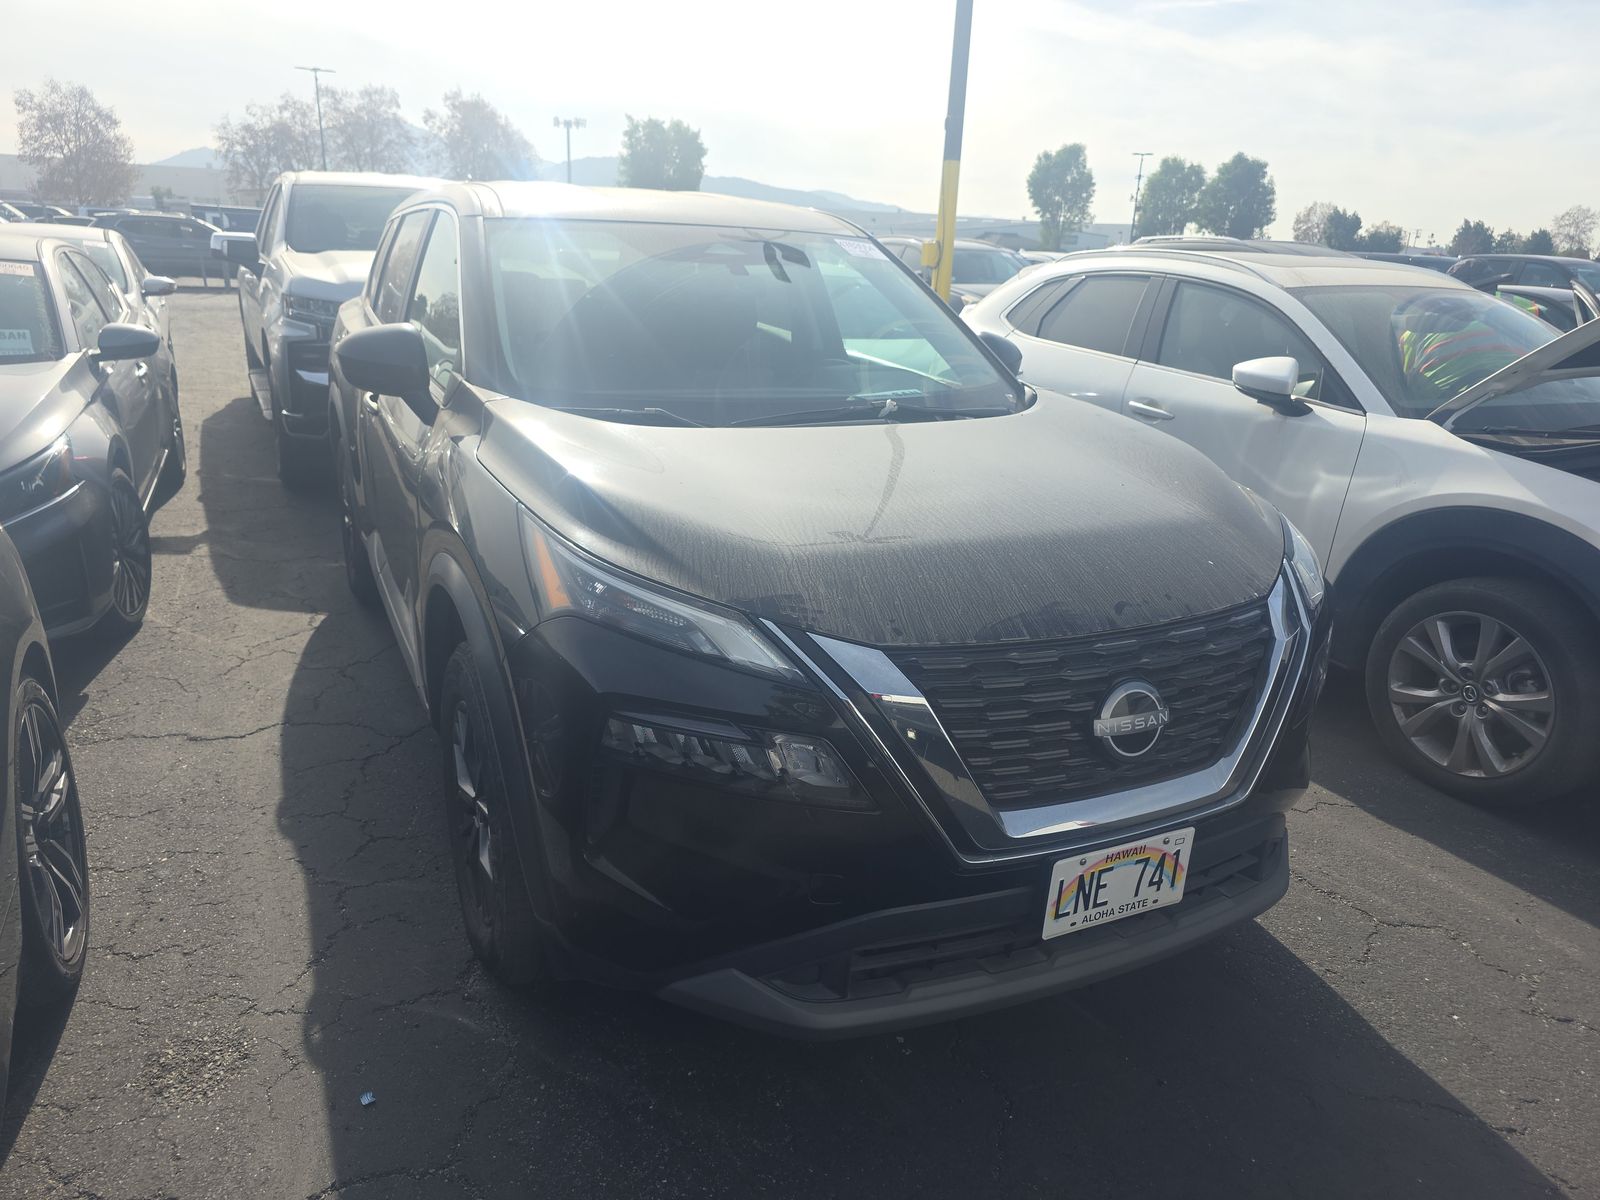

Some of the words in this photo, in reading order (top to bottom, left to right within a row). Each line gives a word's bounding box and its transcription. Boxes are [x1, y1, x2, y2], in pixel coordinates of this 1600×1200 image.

[1097, 710, 1168, 733] NISSAN
[1105, 845, 1147, 864] HAWAII
[1054, 866, 1114, 920] LNE
[1133, 849, 1181, 898] 741
[1081, 909, 1115, 925] ALOHA
[1118, 899, 1149, 914] STATE
